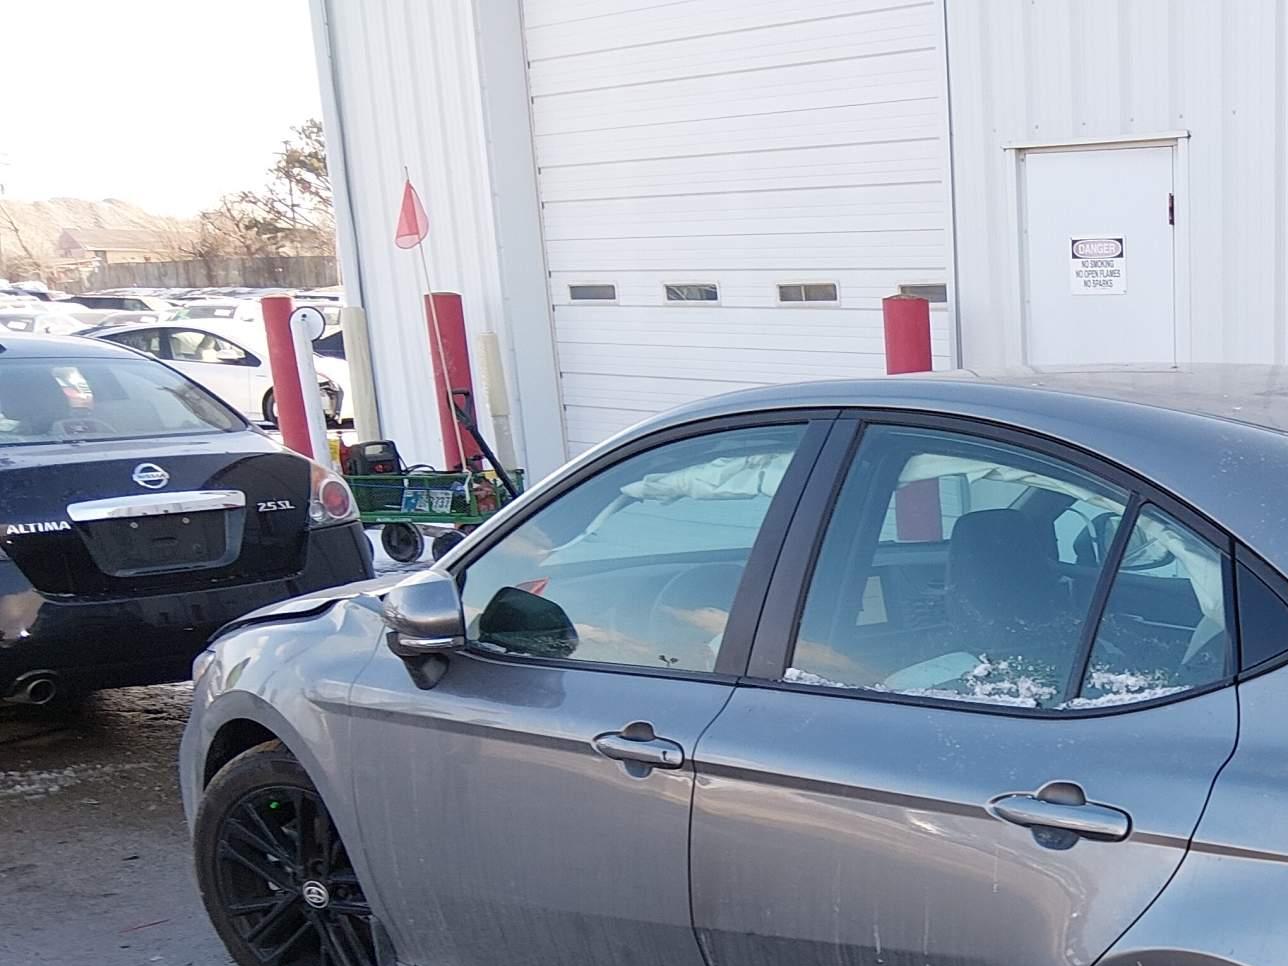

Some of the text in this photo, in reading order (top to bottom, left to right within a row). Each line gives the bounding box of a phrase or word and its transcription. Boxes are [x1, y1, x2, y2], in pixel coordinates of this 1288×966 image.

[1078, 243, 1116, 255] DANGER
[1081, 260, 1114, 268] NO SMOKING
[1075, 269, 1121, 278] NO OPEN FLAMES
[1083, 279, 1091, 288] NO
[6, 520, 72, 535] ALTIMA
